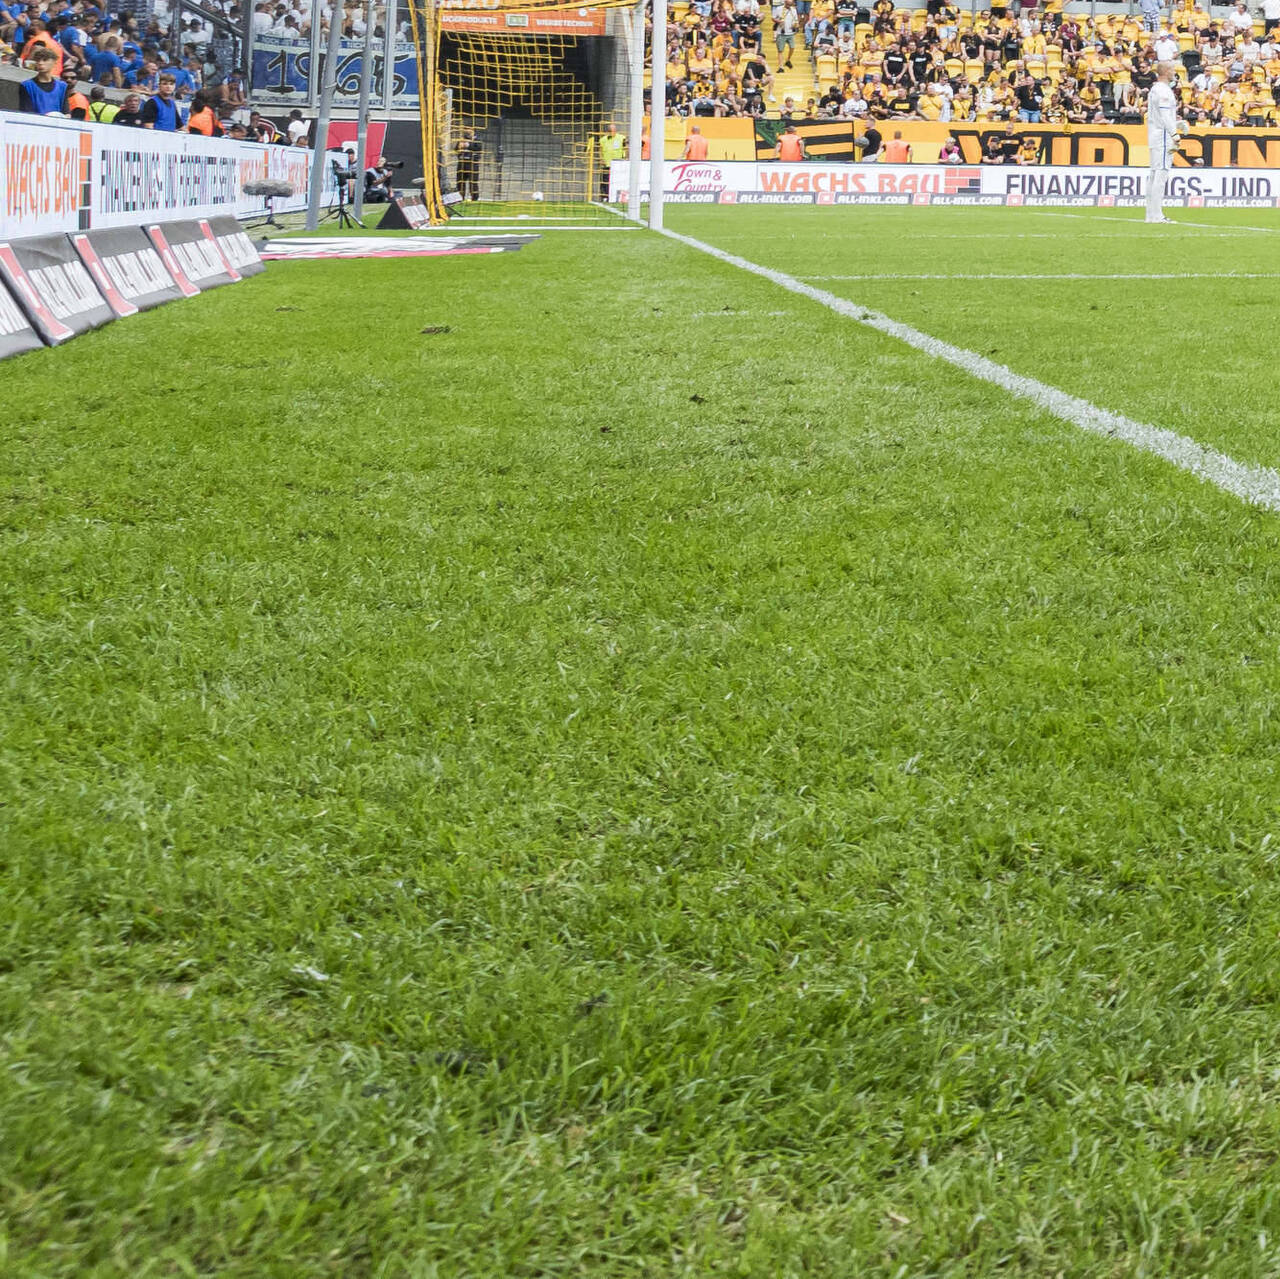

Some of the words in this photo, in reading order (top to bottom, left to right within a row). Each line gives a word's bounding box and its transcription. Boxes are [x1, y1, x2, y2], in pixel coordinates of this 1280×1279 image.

[672, 163, 712, 181] Town
[713, 169, 722, 181] &
[673, 178, 727, 193] Country
[760, 171, 873, 193] WACHS
[879, 173, 940, 195] BAU
[1222, 176, 1271, 198] UND
